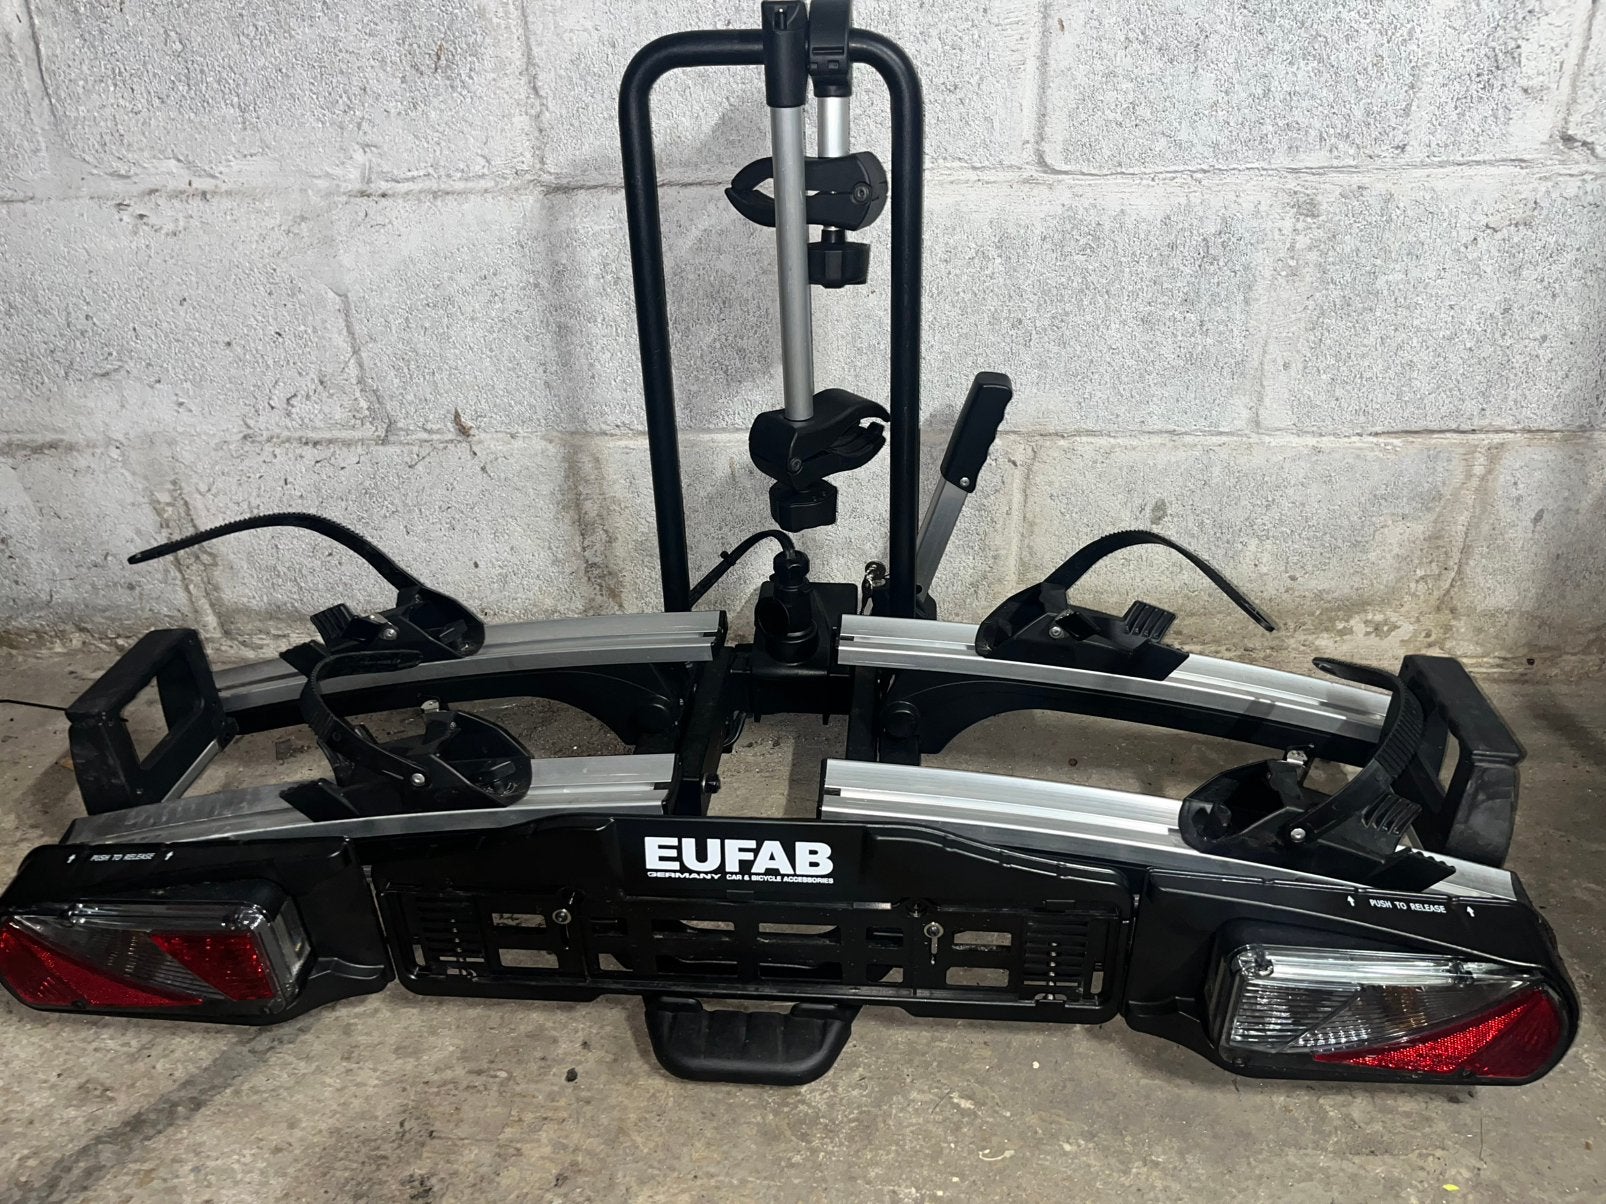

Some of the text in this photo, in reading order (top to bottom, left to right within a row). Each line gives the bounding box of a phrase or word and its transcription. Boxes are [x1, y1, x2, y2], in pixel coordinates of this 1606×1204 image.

[644, 837, 834, 876] EUFAB
[647, 871, 722, 880] GERMANY
[783, 876, 834, 884] ACCESSORIES
[1369, 899, 1447, 914] PUSH TO RELEASE
